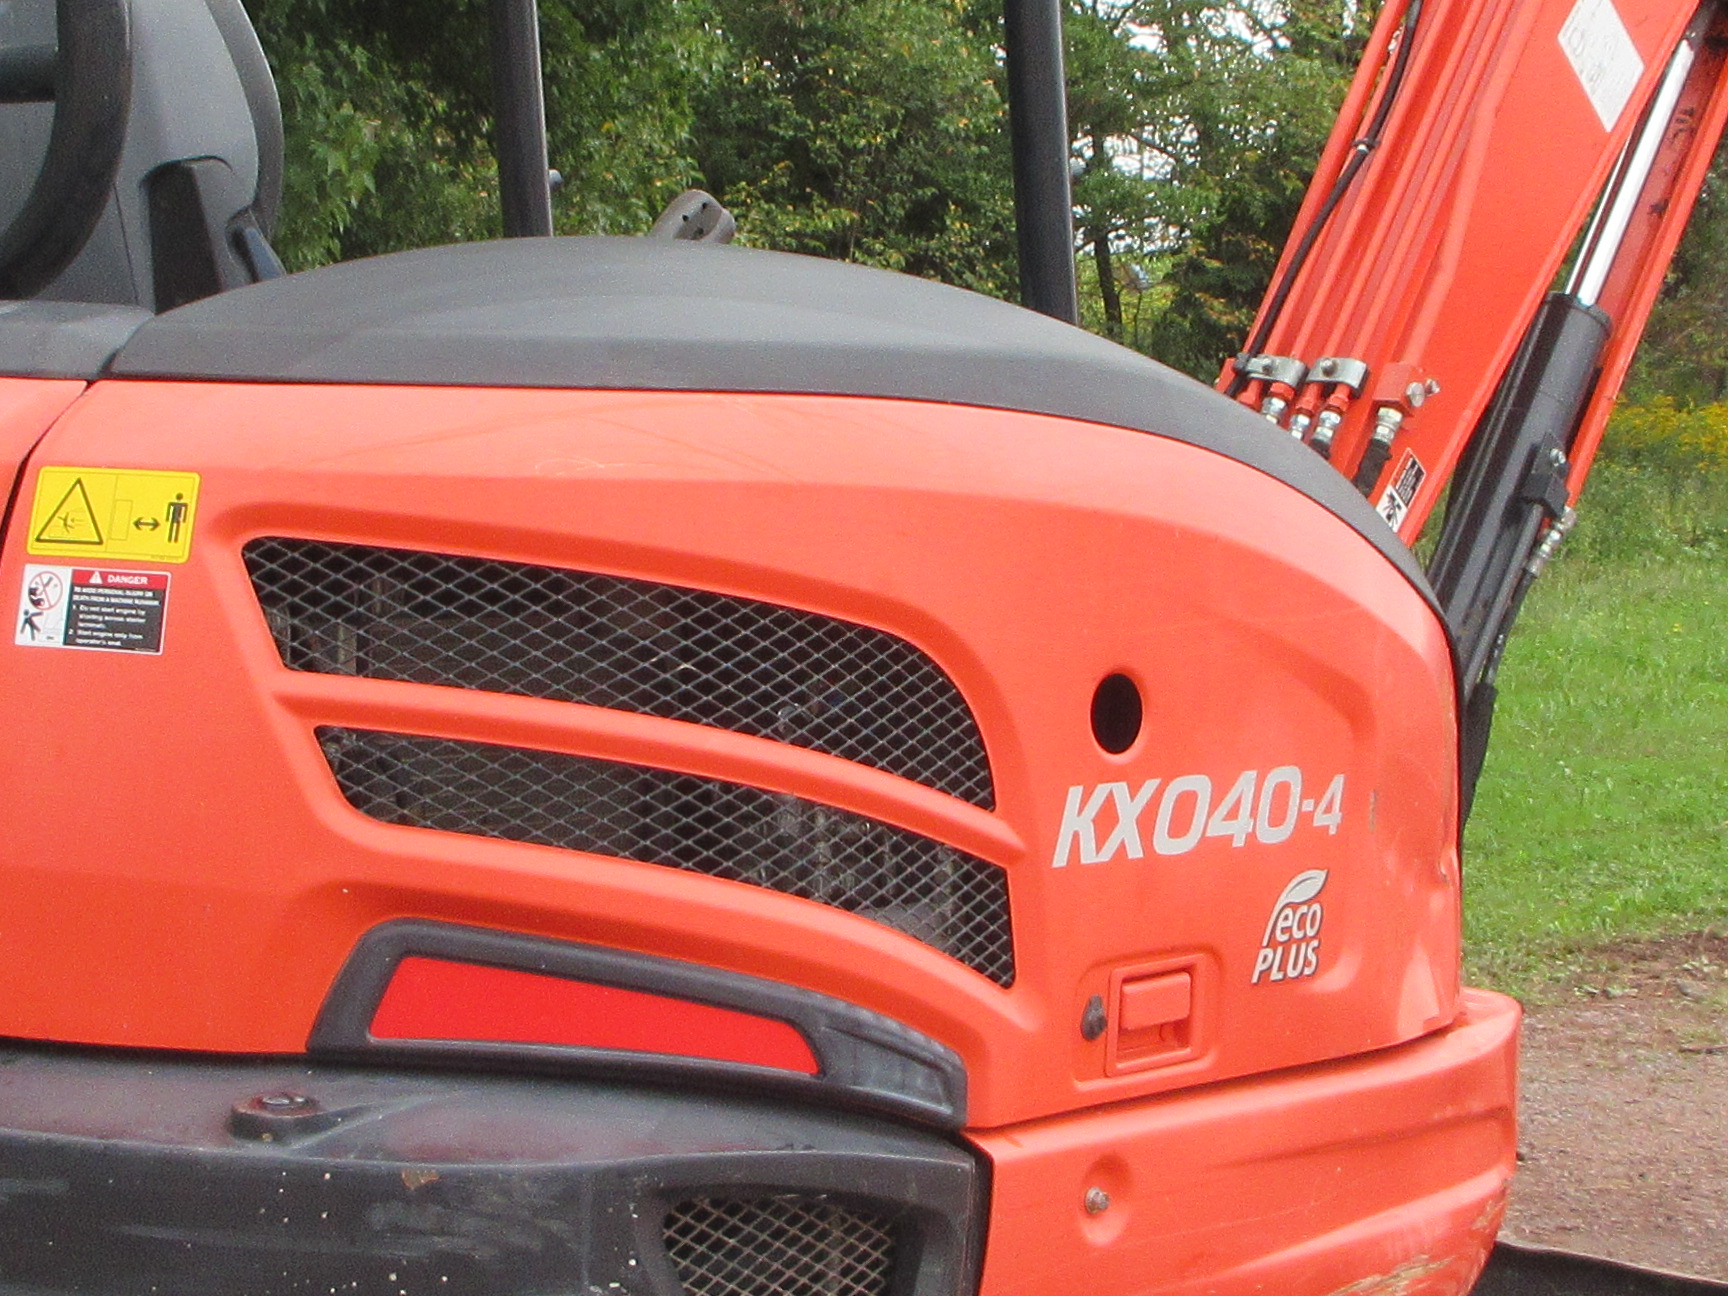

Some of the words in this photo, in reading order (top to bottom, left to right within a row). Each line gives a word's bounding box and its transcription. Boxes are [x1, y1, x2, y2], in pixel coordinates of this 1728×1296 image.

[107, 575, 149, 585] DANGER
[1052, 766, 1345, 868] KX040-4
[1275, 902, 1324, 943] eco
[1250, 939, 1321, 984] PLUS
